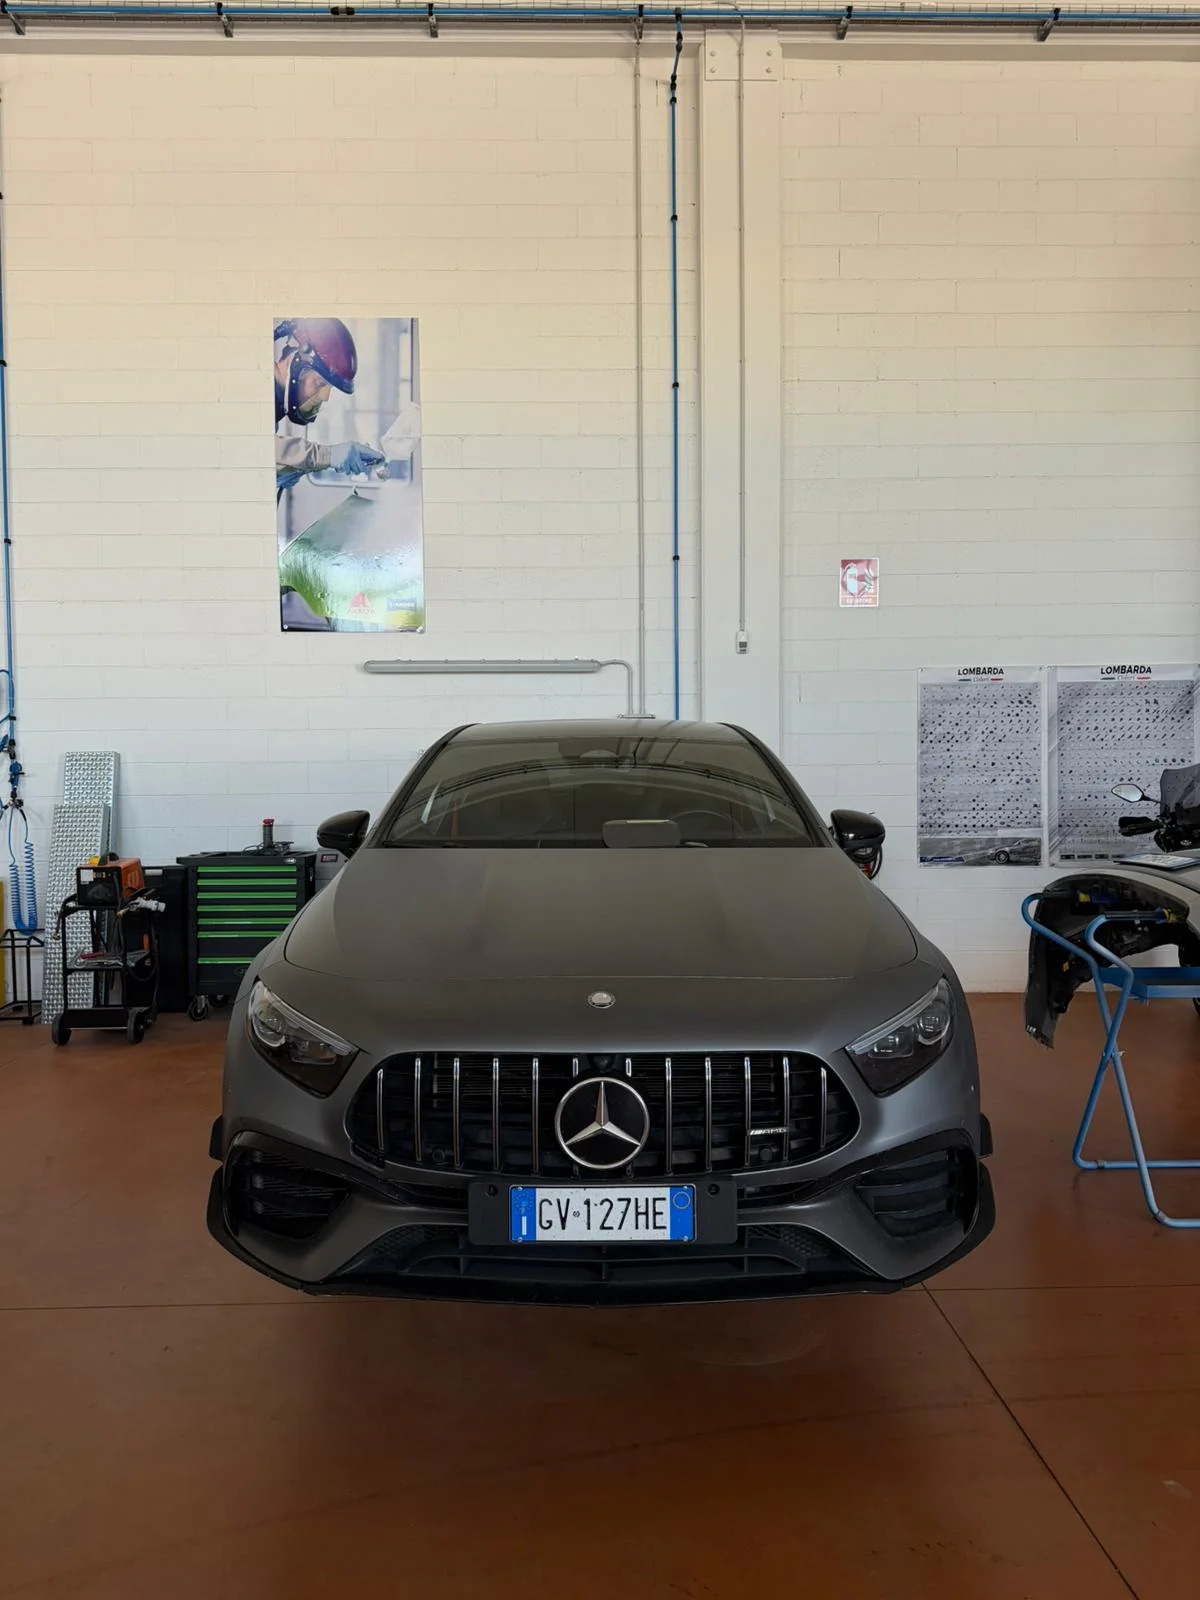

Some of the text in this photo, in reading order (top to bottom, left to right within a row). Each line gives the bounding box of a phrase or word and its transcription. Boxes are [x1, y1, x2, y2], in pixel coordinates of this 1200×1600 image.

[958, 667, 1004, 676] LOMBARDA
[1101, 665, 1152, 675] LOMBARDA
[539, 1198, 667, 1230] GV 127HE
